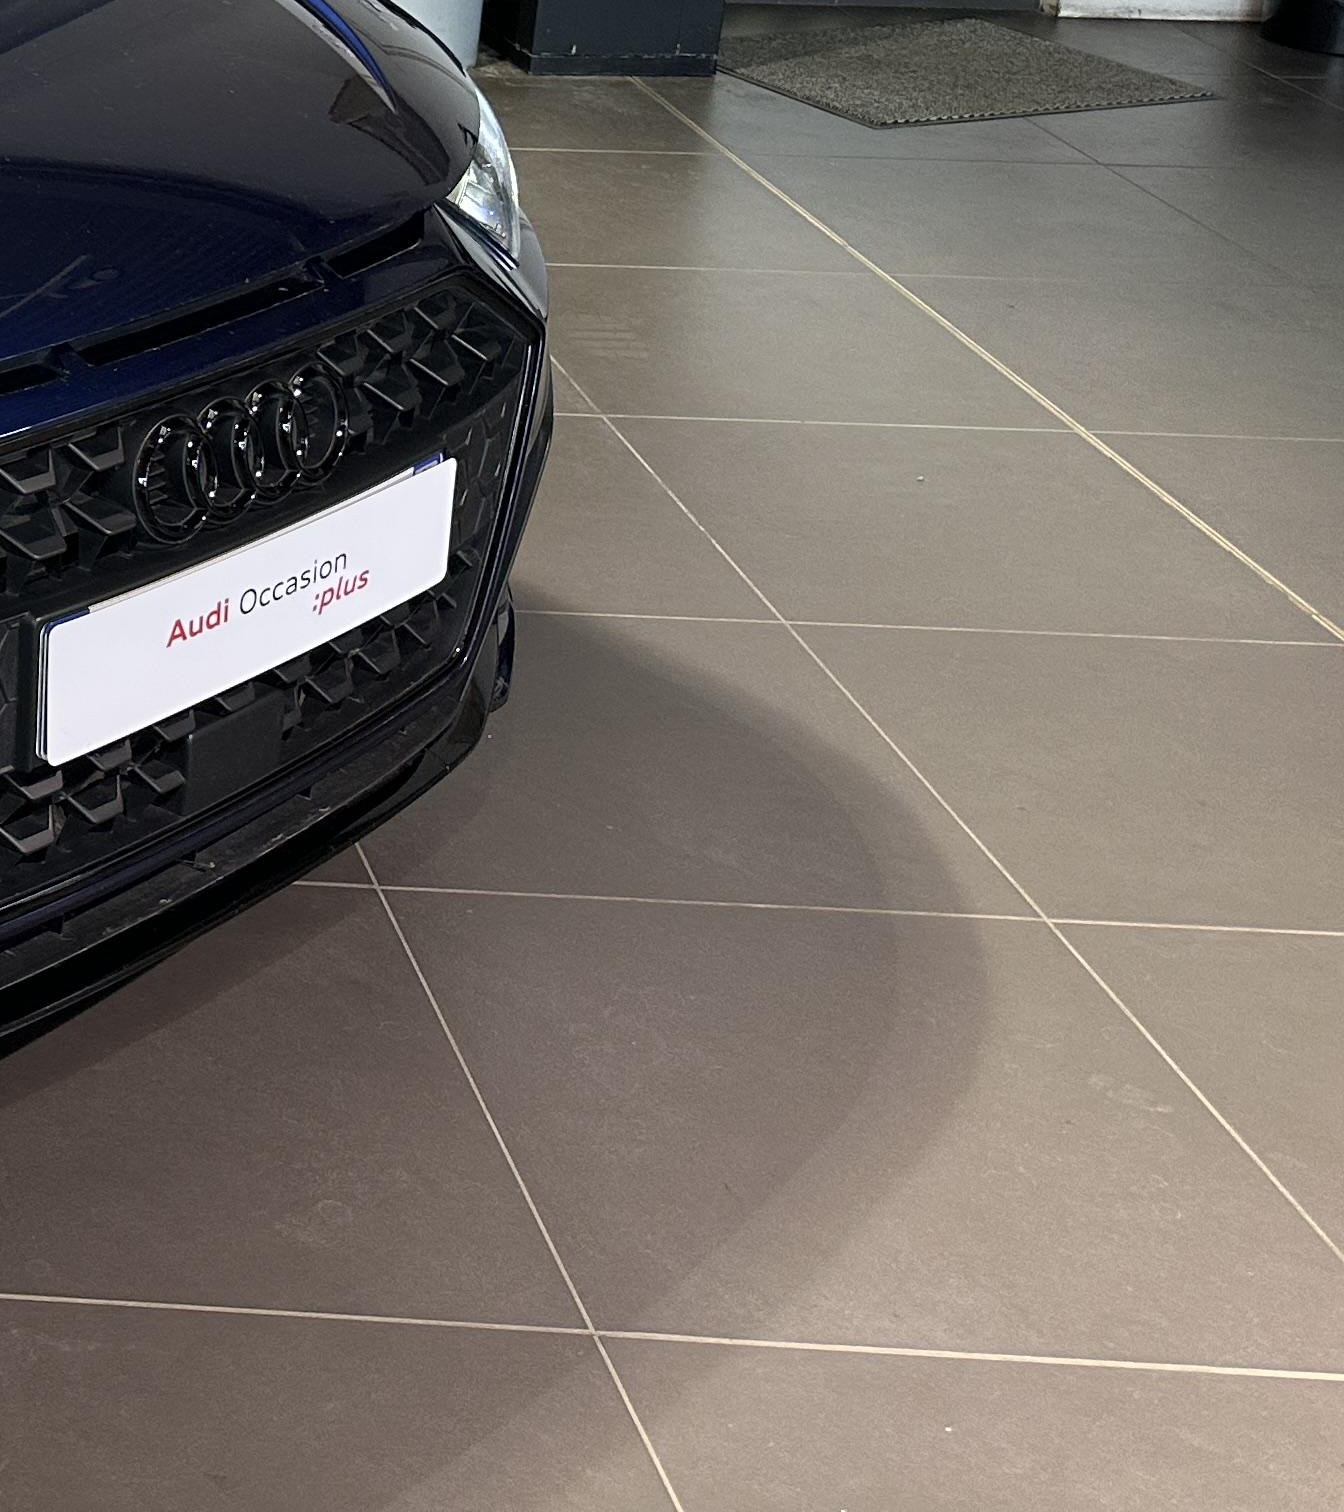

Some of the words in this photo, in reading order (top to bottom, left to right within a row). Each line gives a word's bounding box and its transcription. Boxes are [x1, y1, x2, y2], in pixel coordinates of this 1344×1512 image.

[166, 598, 229, 648] Audi
[239, 551, 348, 615] Occasion
[312, 568, 370, 615] :plus
